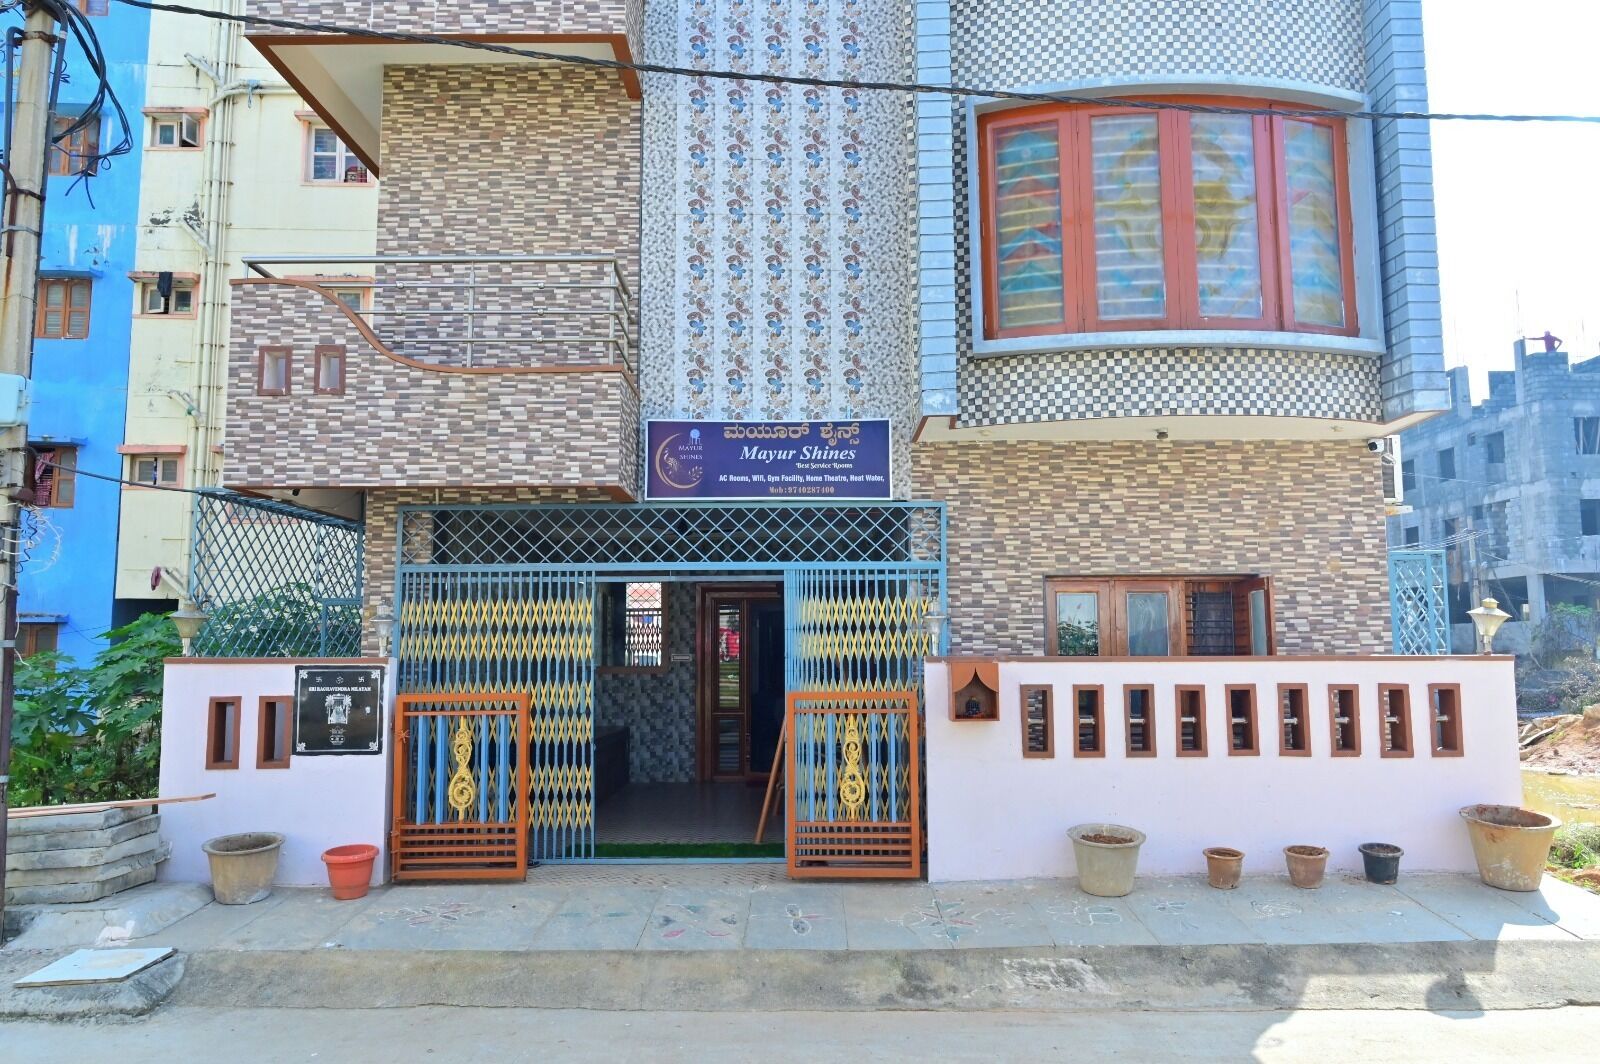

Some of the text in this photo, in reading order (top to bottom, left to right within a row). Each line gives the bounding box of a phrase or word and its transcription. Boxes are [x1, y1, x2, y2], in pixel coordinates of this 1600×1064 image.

[740, 445, 857, 464] Mayur Shines
[810, 462, 831, 470] Service
[832, 462, 853, 470] Rooms
[719, 474, 728, 482] AC
[729, 474, 751, 483] Rooms,
[767, 474, 780, 483] Gym
[781, 474, 805, 483] Facility,
[805, 474, 823, 482] Home
[823, 474, 849, 483] Theatre,
